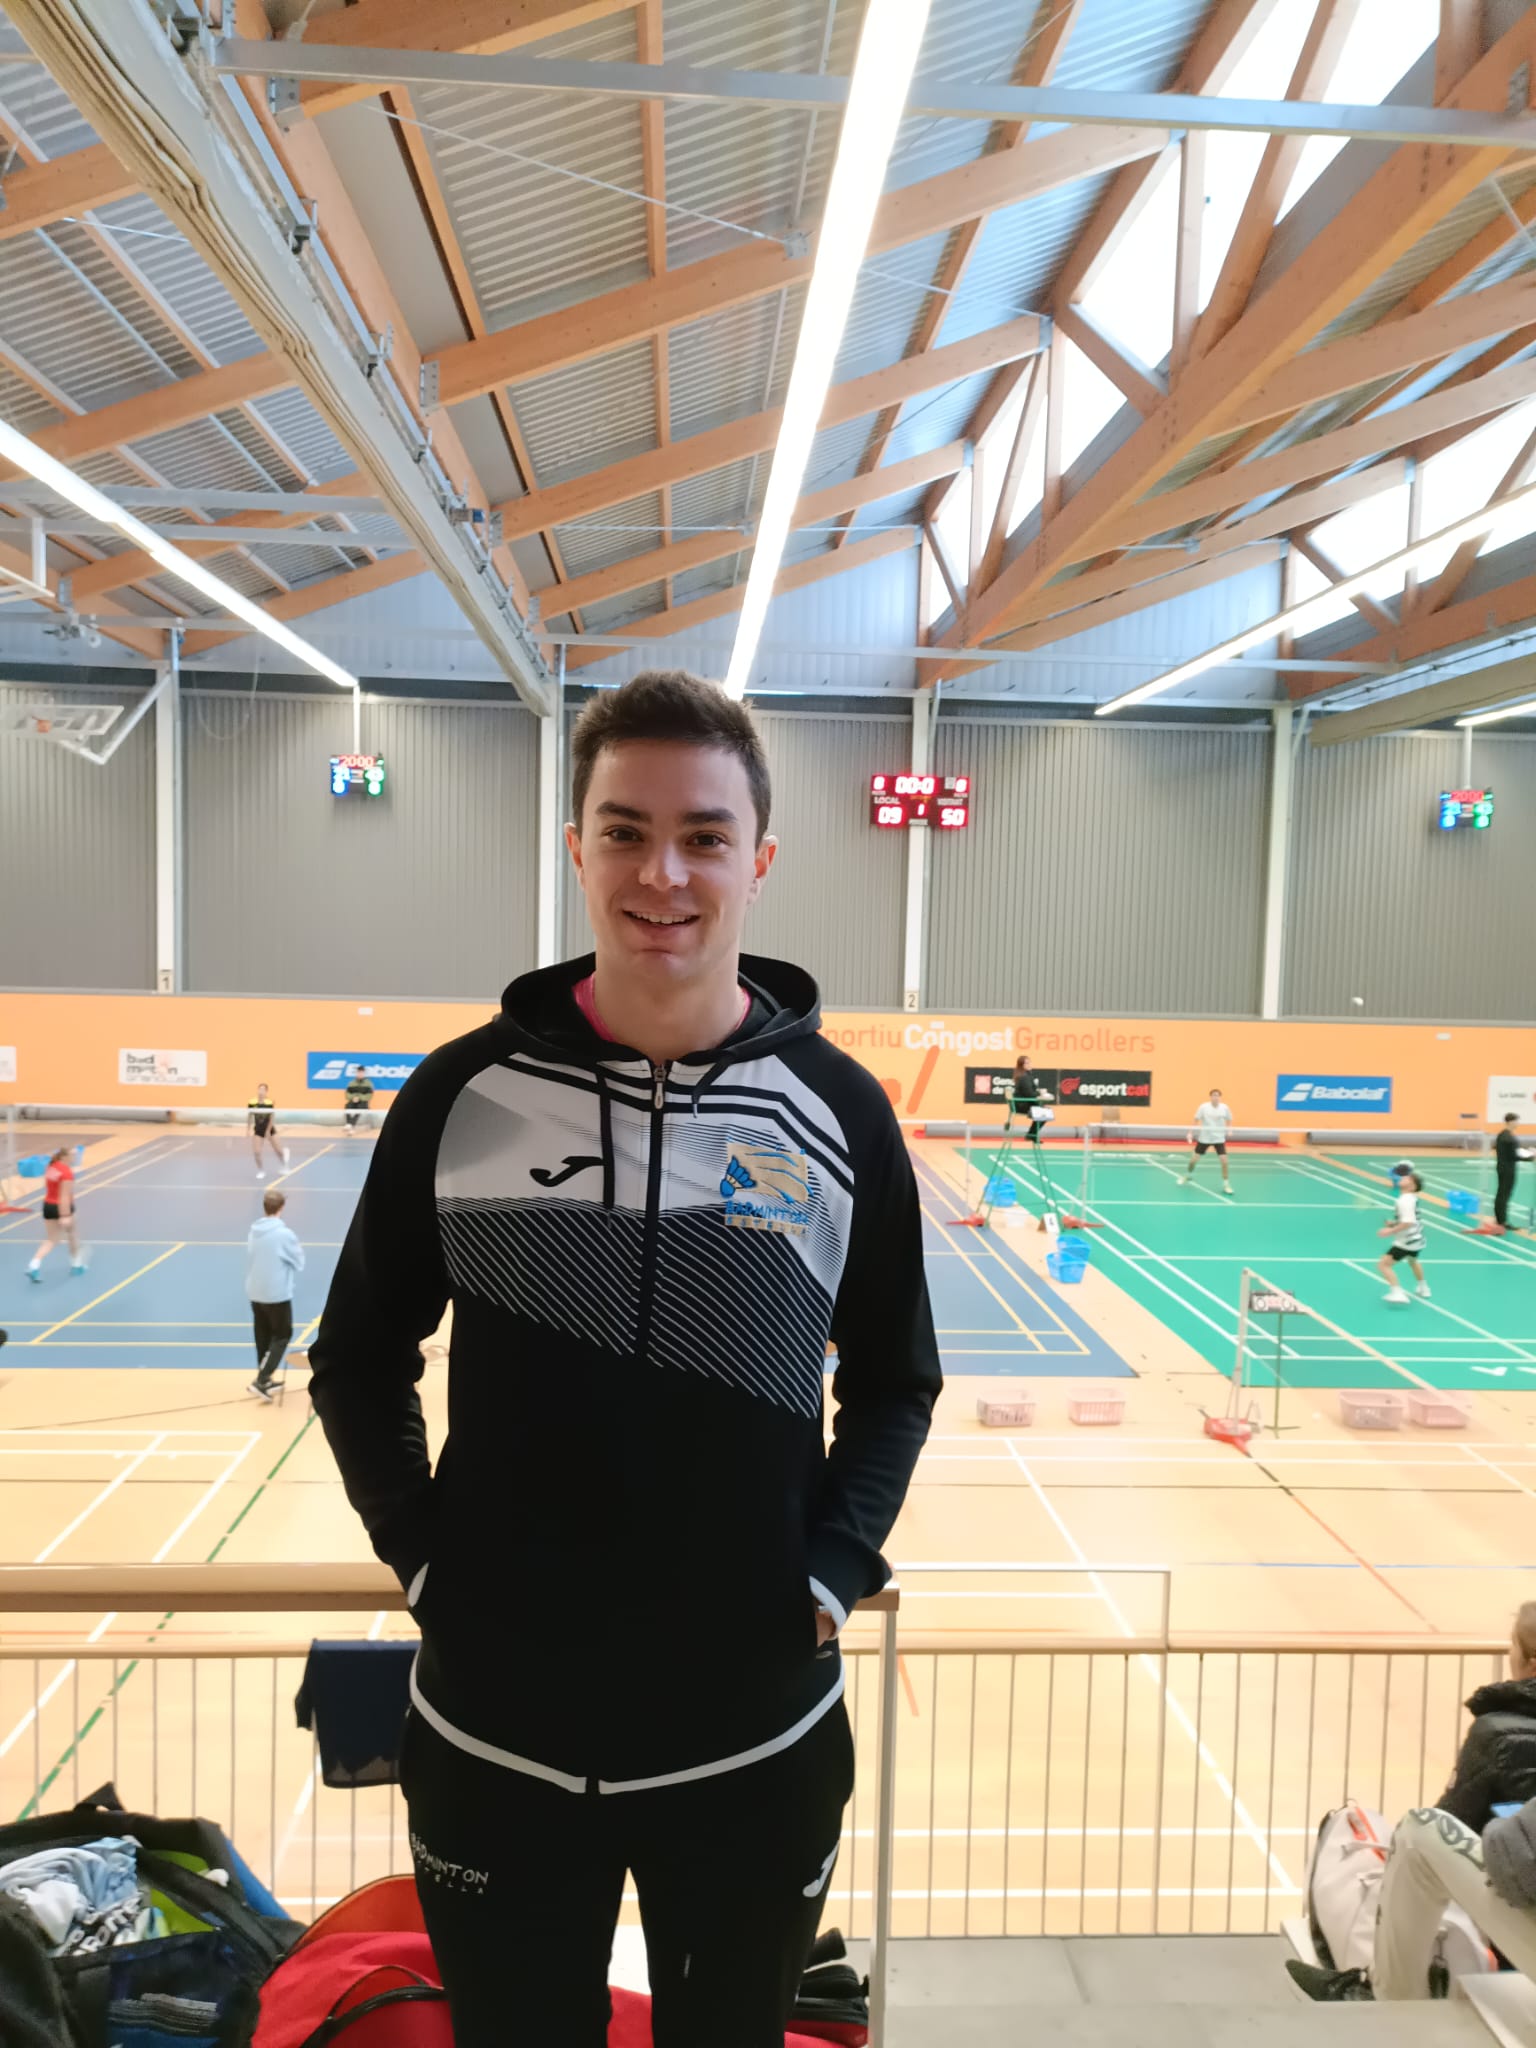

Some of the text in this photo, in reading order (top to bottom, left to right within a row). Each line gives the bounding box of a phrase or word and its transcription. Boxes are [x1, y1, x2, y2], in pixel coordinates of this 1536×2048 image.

[907, 993, 916, 1008] 2
[825, 1022, 1155, 1057] portiu Congost Granollers
[345, 1063, 416, 1079] Bbola
[1311, 1086, 1388, 1101] Babolat
